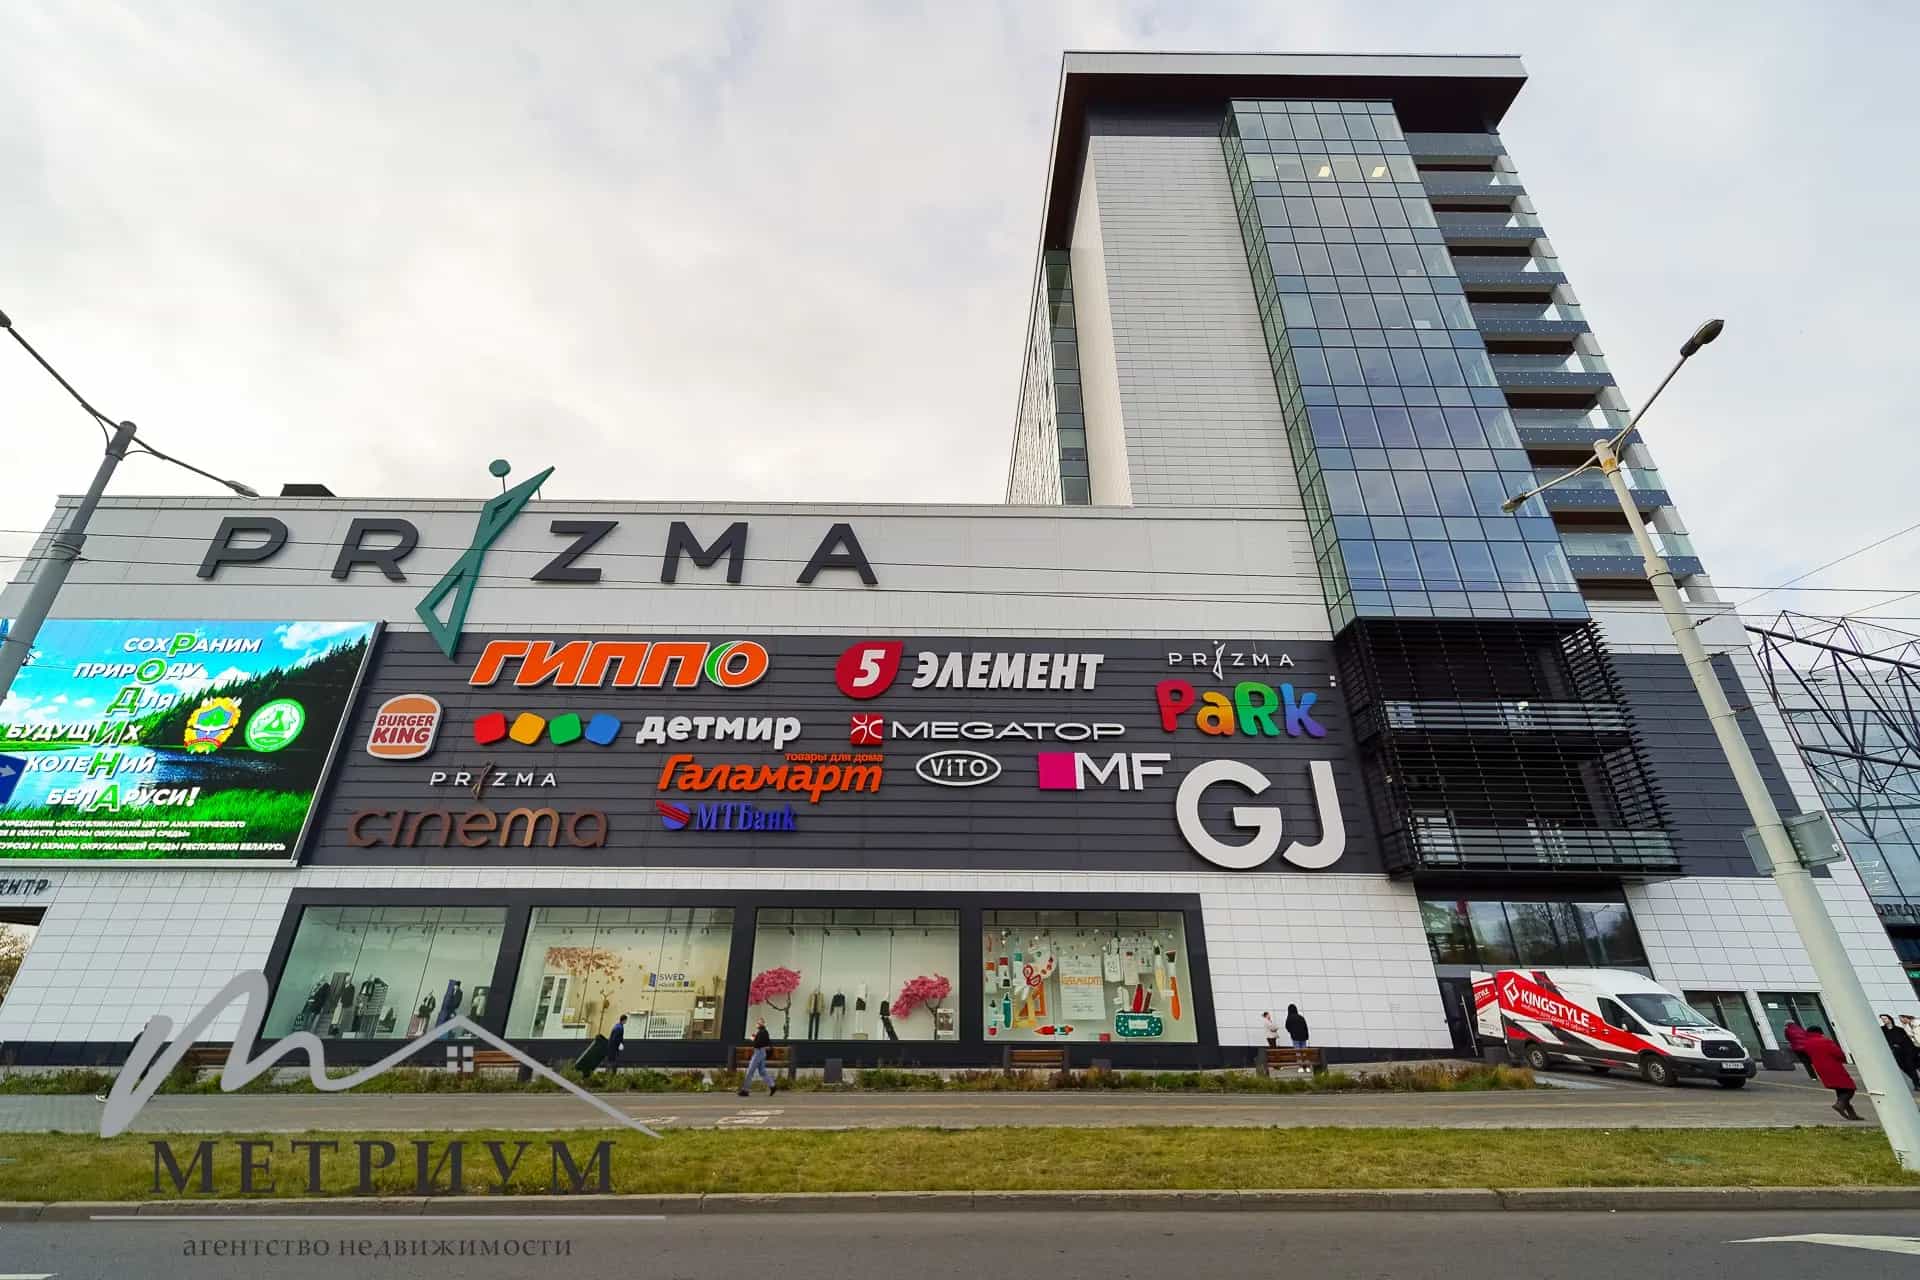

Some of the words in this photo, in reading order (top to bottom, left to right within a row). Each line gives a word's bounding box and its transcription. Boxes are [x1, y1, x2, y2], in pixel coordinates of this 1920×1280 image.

[124, 633, 262, 657] СОХРАНИМ
[73, 658, 204, 684] ПРИРОДУ
[468, 640, 769, 688] ГИППО
[852, 649, 886, 688] 5
[911, 651, 1104, 690] ЭЛЕМЕНТ
[6, 720, 143, 747] БУДУЩИХ
[372, 727, 431, 744] KING
[377, 715, 434, 727] BURGER
[635, 713, 801, 750] детмир
[891, 721, 1125, 741] MEGATOP
[785, 753, 826, 763] товары
[830, 753, 851, 762] для
[854, 753, 883, 763] дома
[1075, 753, 1171, 790] MF
[657, 754, 883, 803] Галамарт
[46, 783, 199, 812] БЕЛАРУСИ!
[346, 806, 609, 848] cinema
[696, 801, 798, 831] МТБанк
[1176, 759, 1346, 869] GJ
[658, 973, 685, 981] SWED
[1521, 989, 1590, 1027] KINGSTYLE
